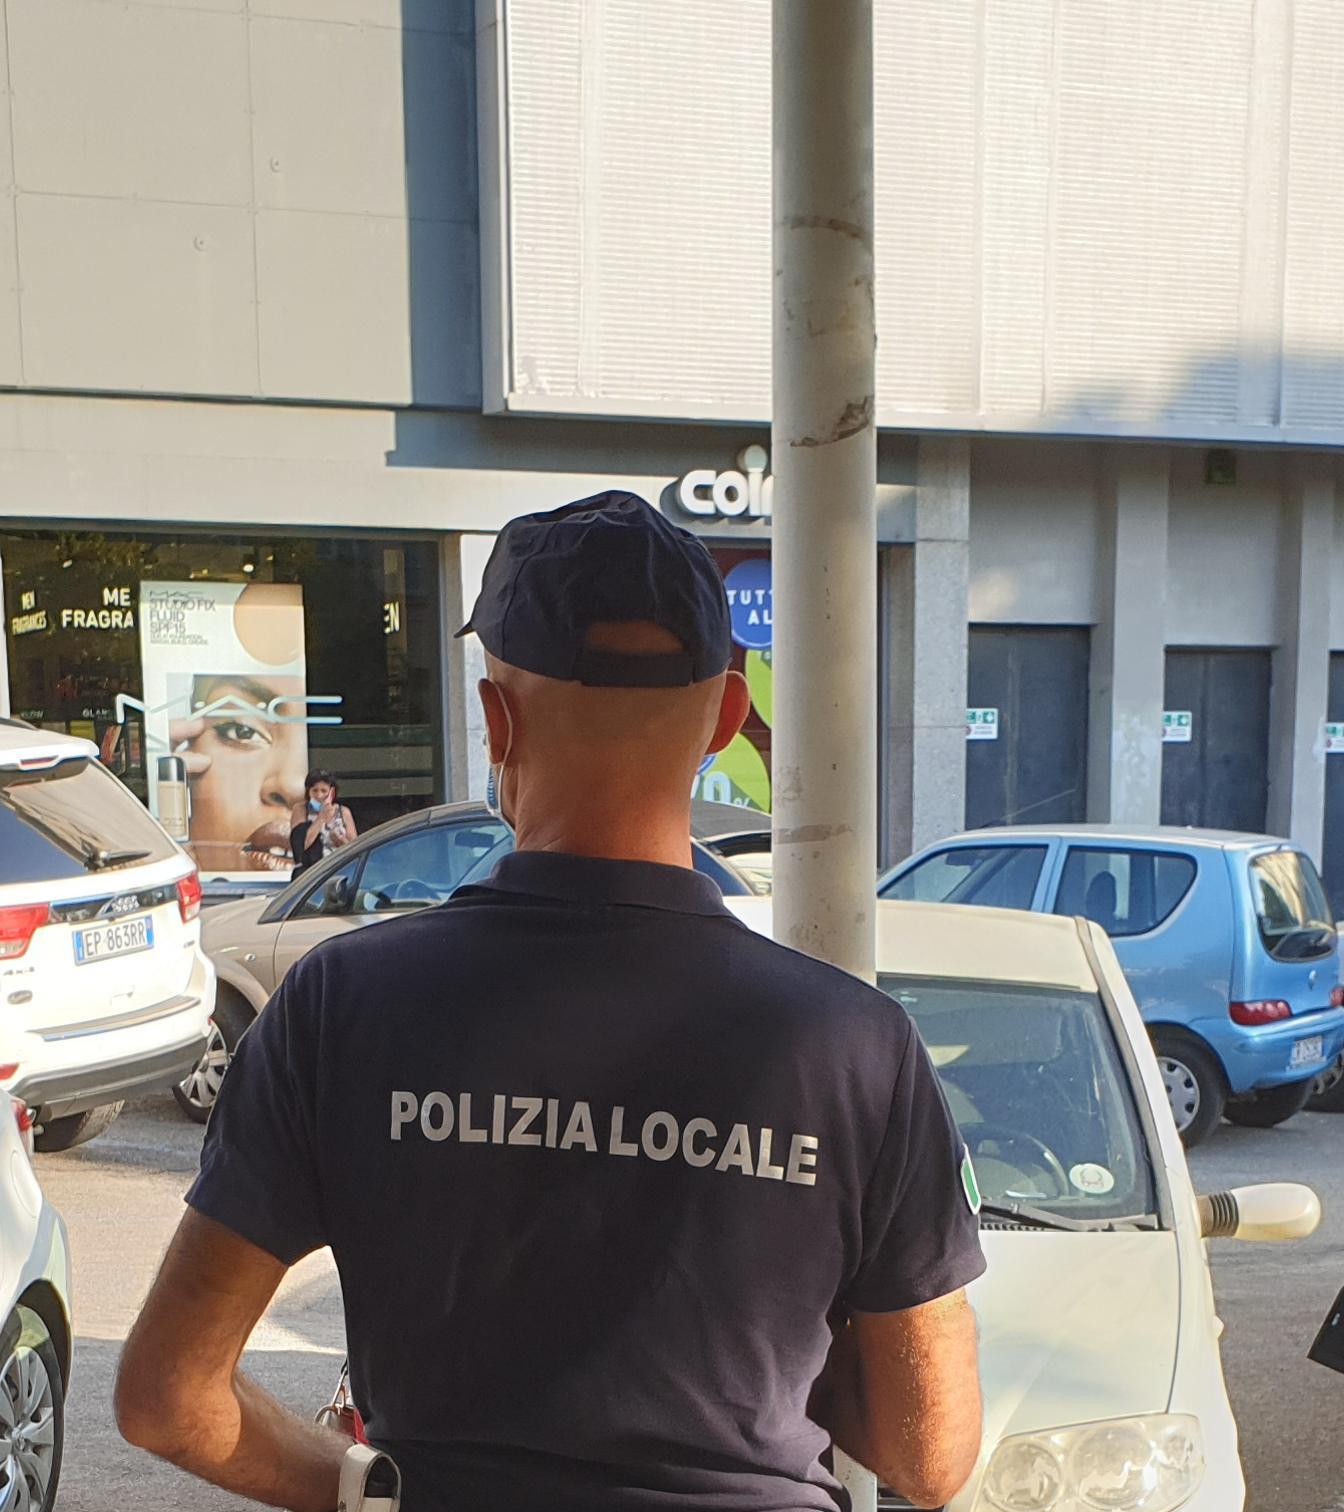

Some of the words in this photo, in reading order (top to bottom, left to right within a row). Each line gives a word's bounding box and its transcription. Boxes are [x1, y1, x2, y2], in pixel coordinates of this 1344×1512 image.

[107, 920, 147, 951] 863RR
[390, 1090, 598, 1153] POLIZIA
[608, 1105, 819, 1187] LOCALE
